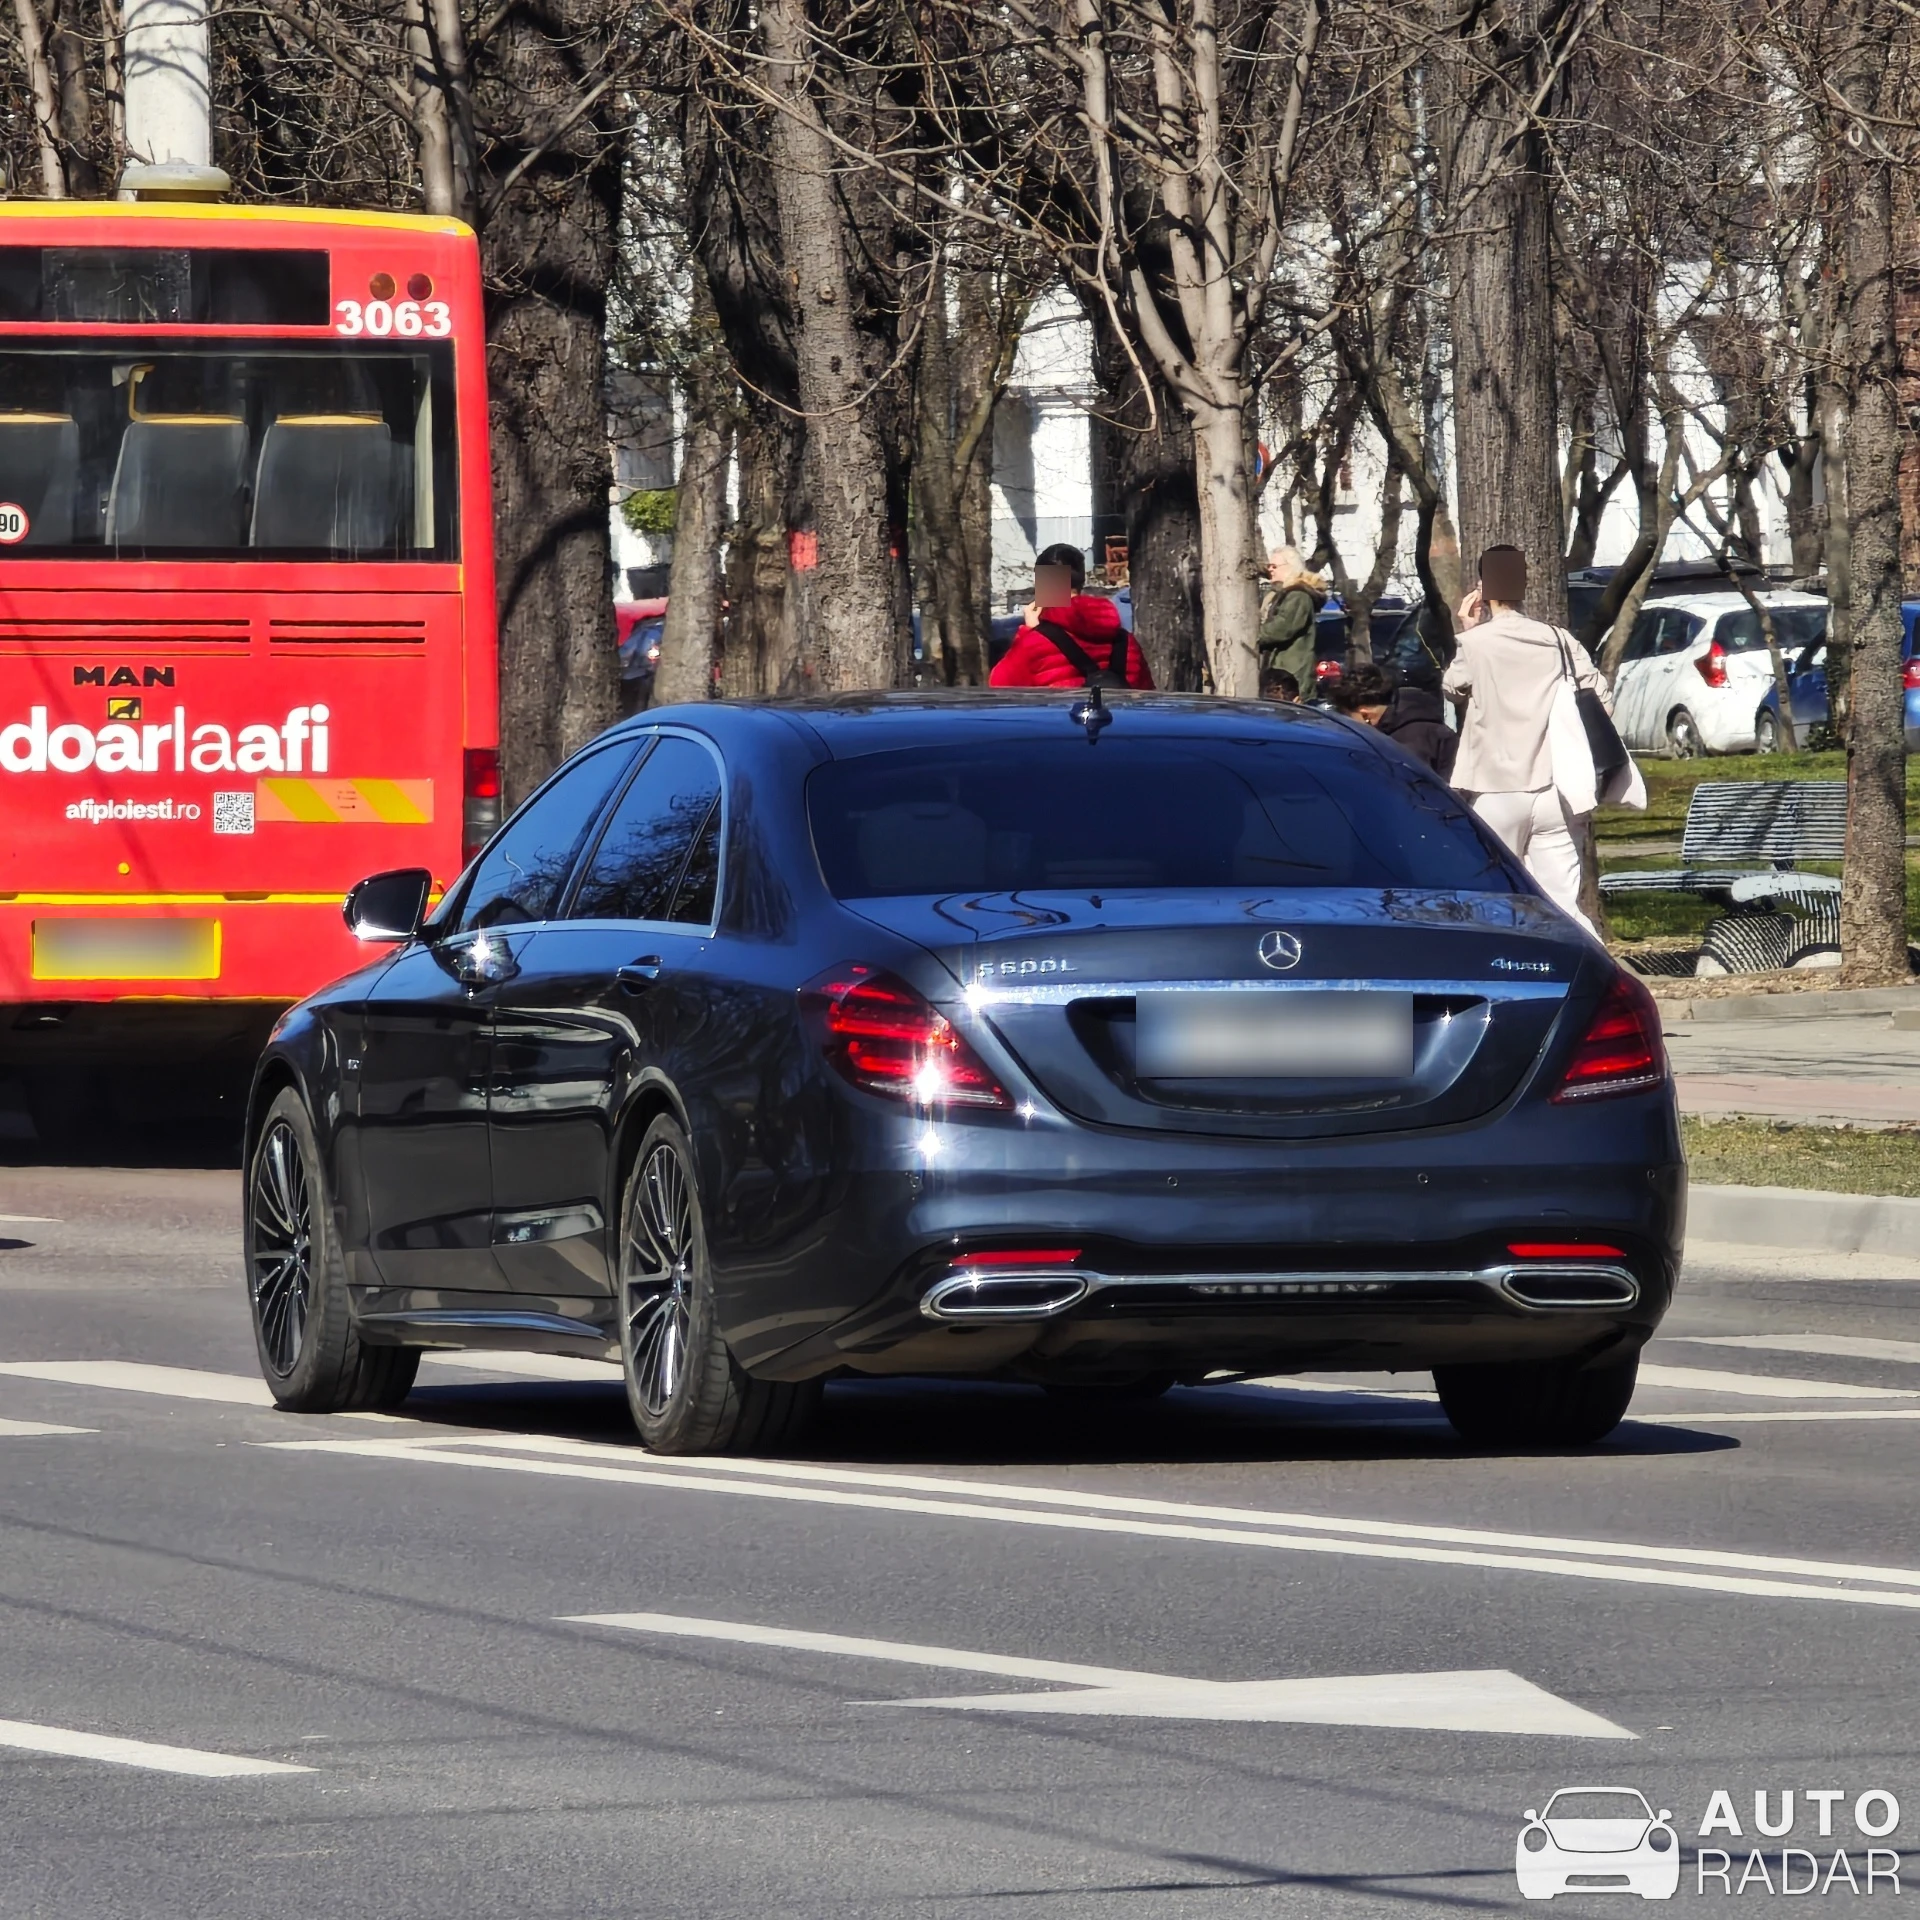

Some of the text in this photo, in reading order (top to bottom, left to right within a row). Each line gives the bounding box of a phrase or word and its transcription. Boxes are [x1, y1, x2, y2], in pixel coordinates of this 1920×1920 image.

[335, 300, 452, 337] 3063
[0, 514, 19, 532] 90
[73, 666, 175, 687] MAN
[65, 798, 201, 825] afiploiesti.ro
